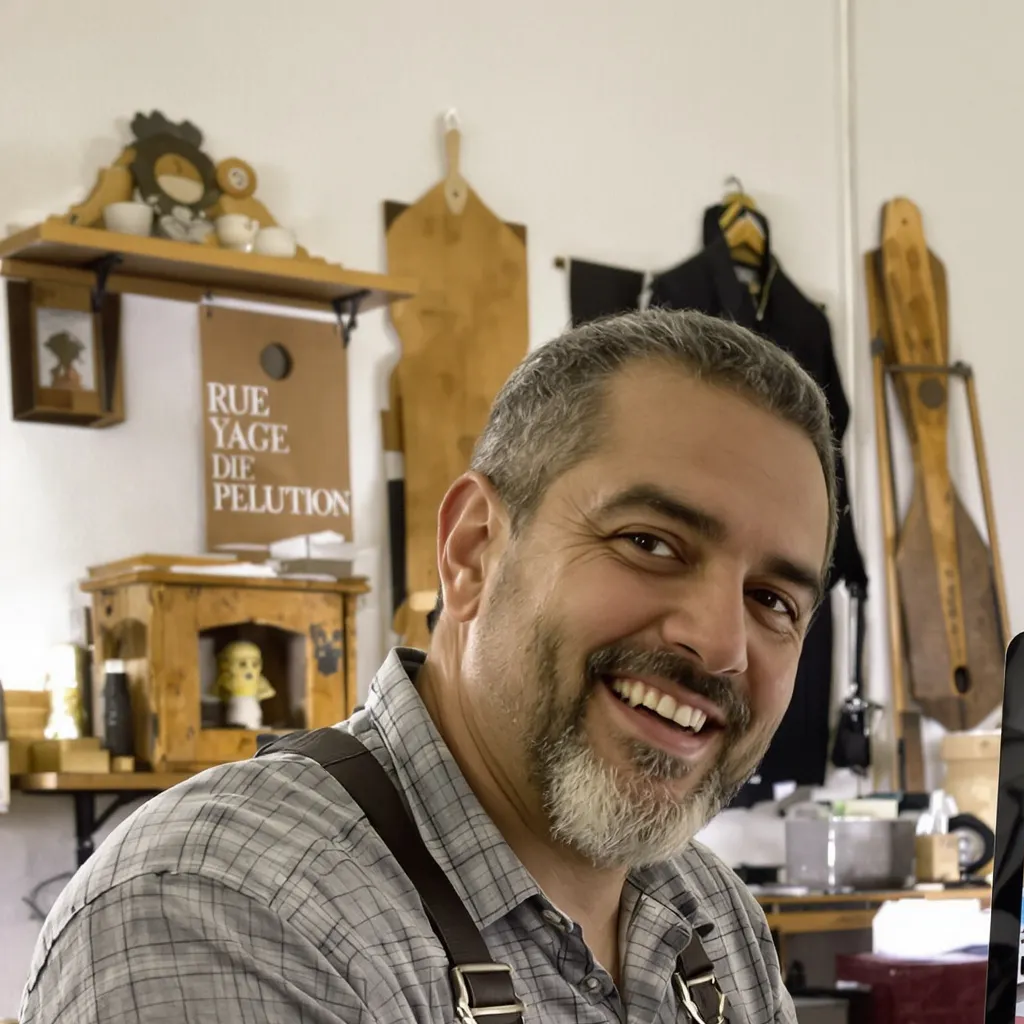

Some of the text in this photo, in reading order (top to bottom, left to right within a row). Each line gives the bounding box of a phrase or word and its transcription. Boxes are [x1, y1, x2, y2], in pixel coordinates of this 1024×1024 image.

[207, 382, 270, 417] RUE
[209, 416, 290, 454] YAGE
[212, 453, 255, 481] DIE
[213, 481, 350, 517] PELUTION
